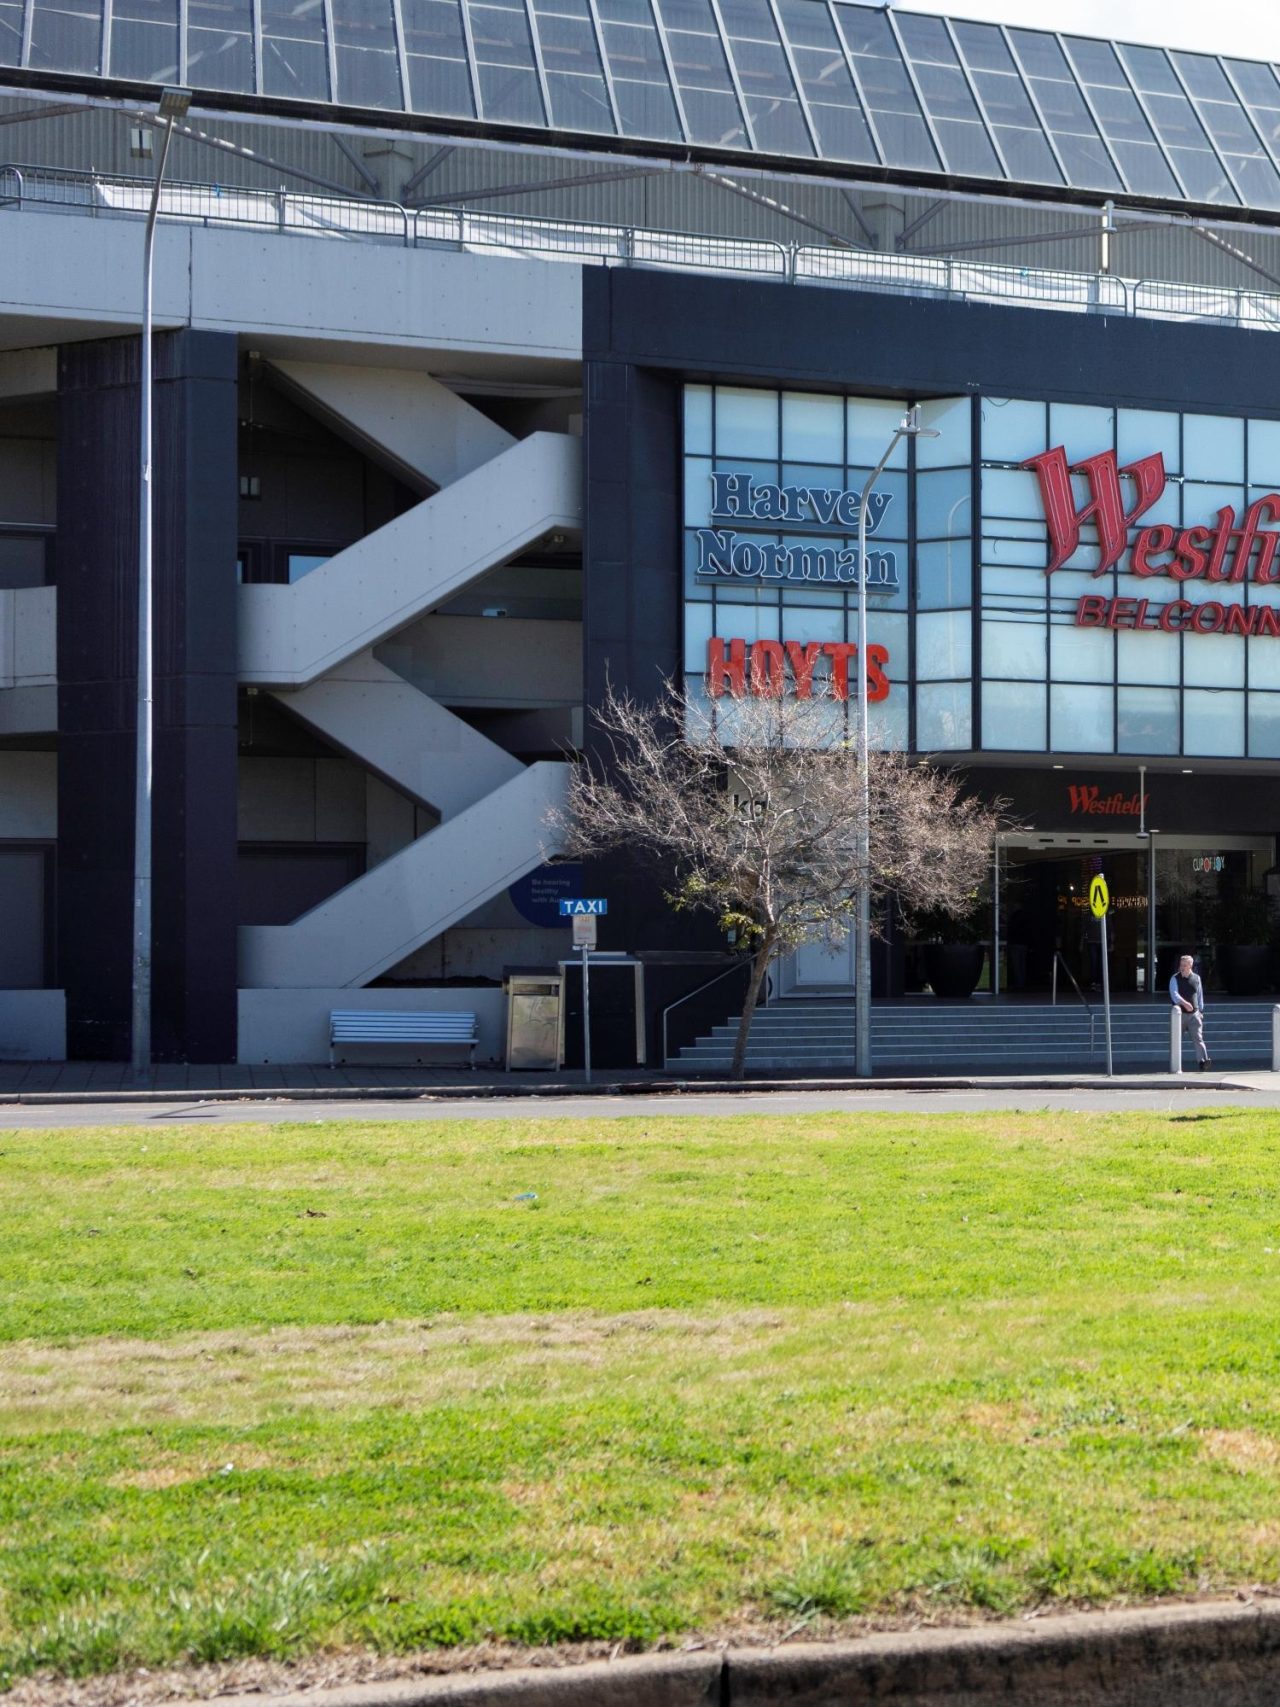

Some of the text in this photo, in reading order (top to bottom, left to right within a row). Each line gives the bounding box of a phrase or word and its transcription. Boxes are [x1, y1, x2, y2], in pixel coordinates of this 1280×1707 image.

[711, 471, 894, 535] Harvey
[696, 529, 900, 585] Norman
[708, 637, 890, 703] HOYTS
[1066, 783, 1150, 815] Westfield
[564, 900, 602, 913] TAXI
